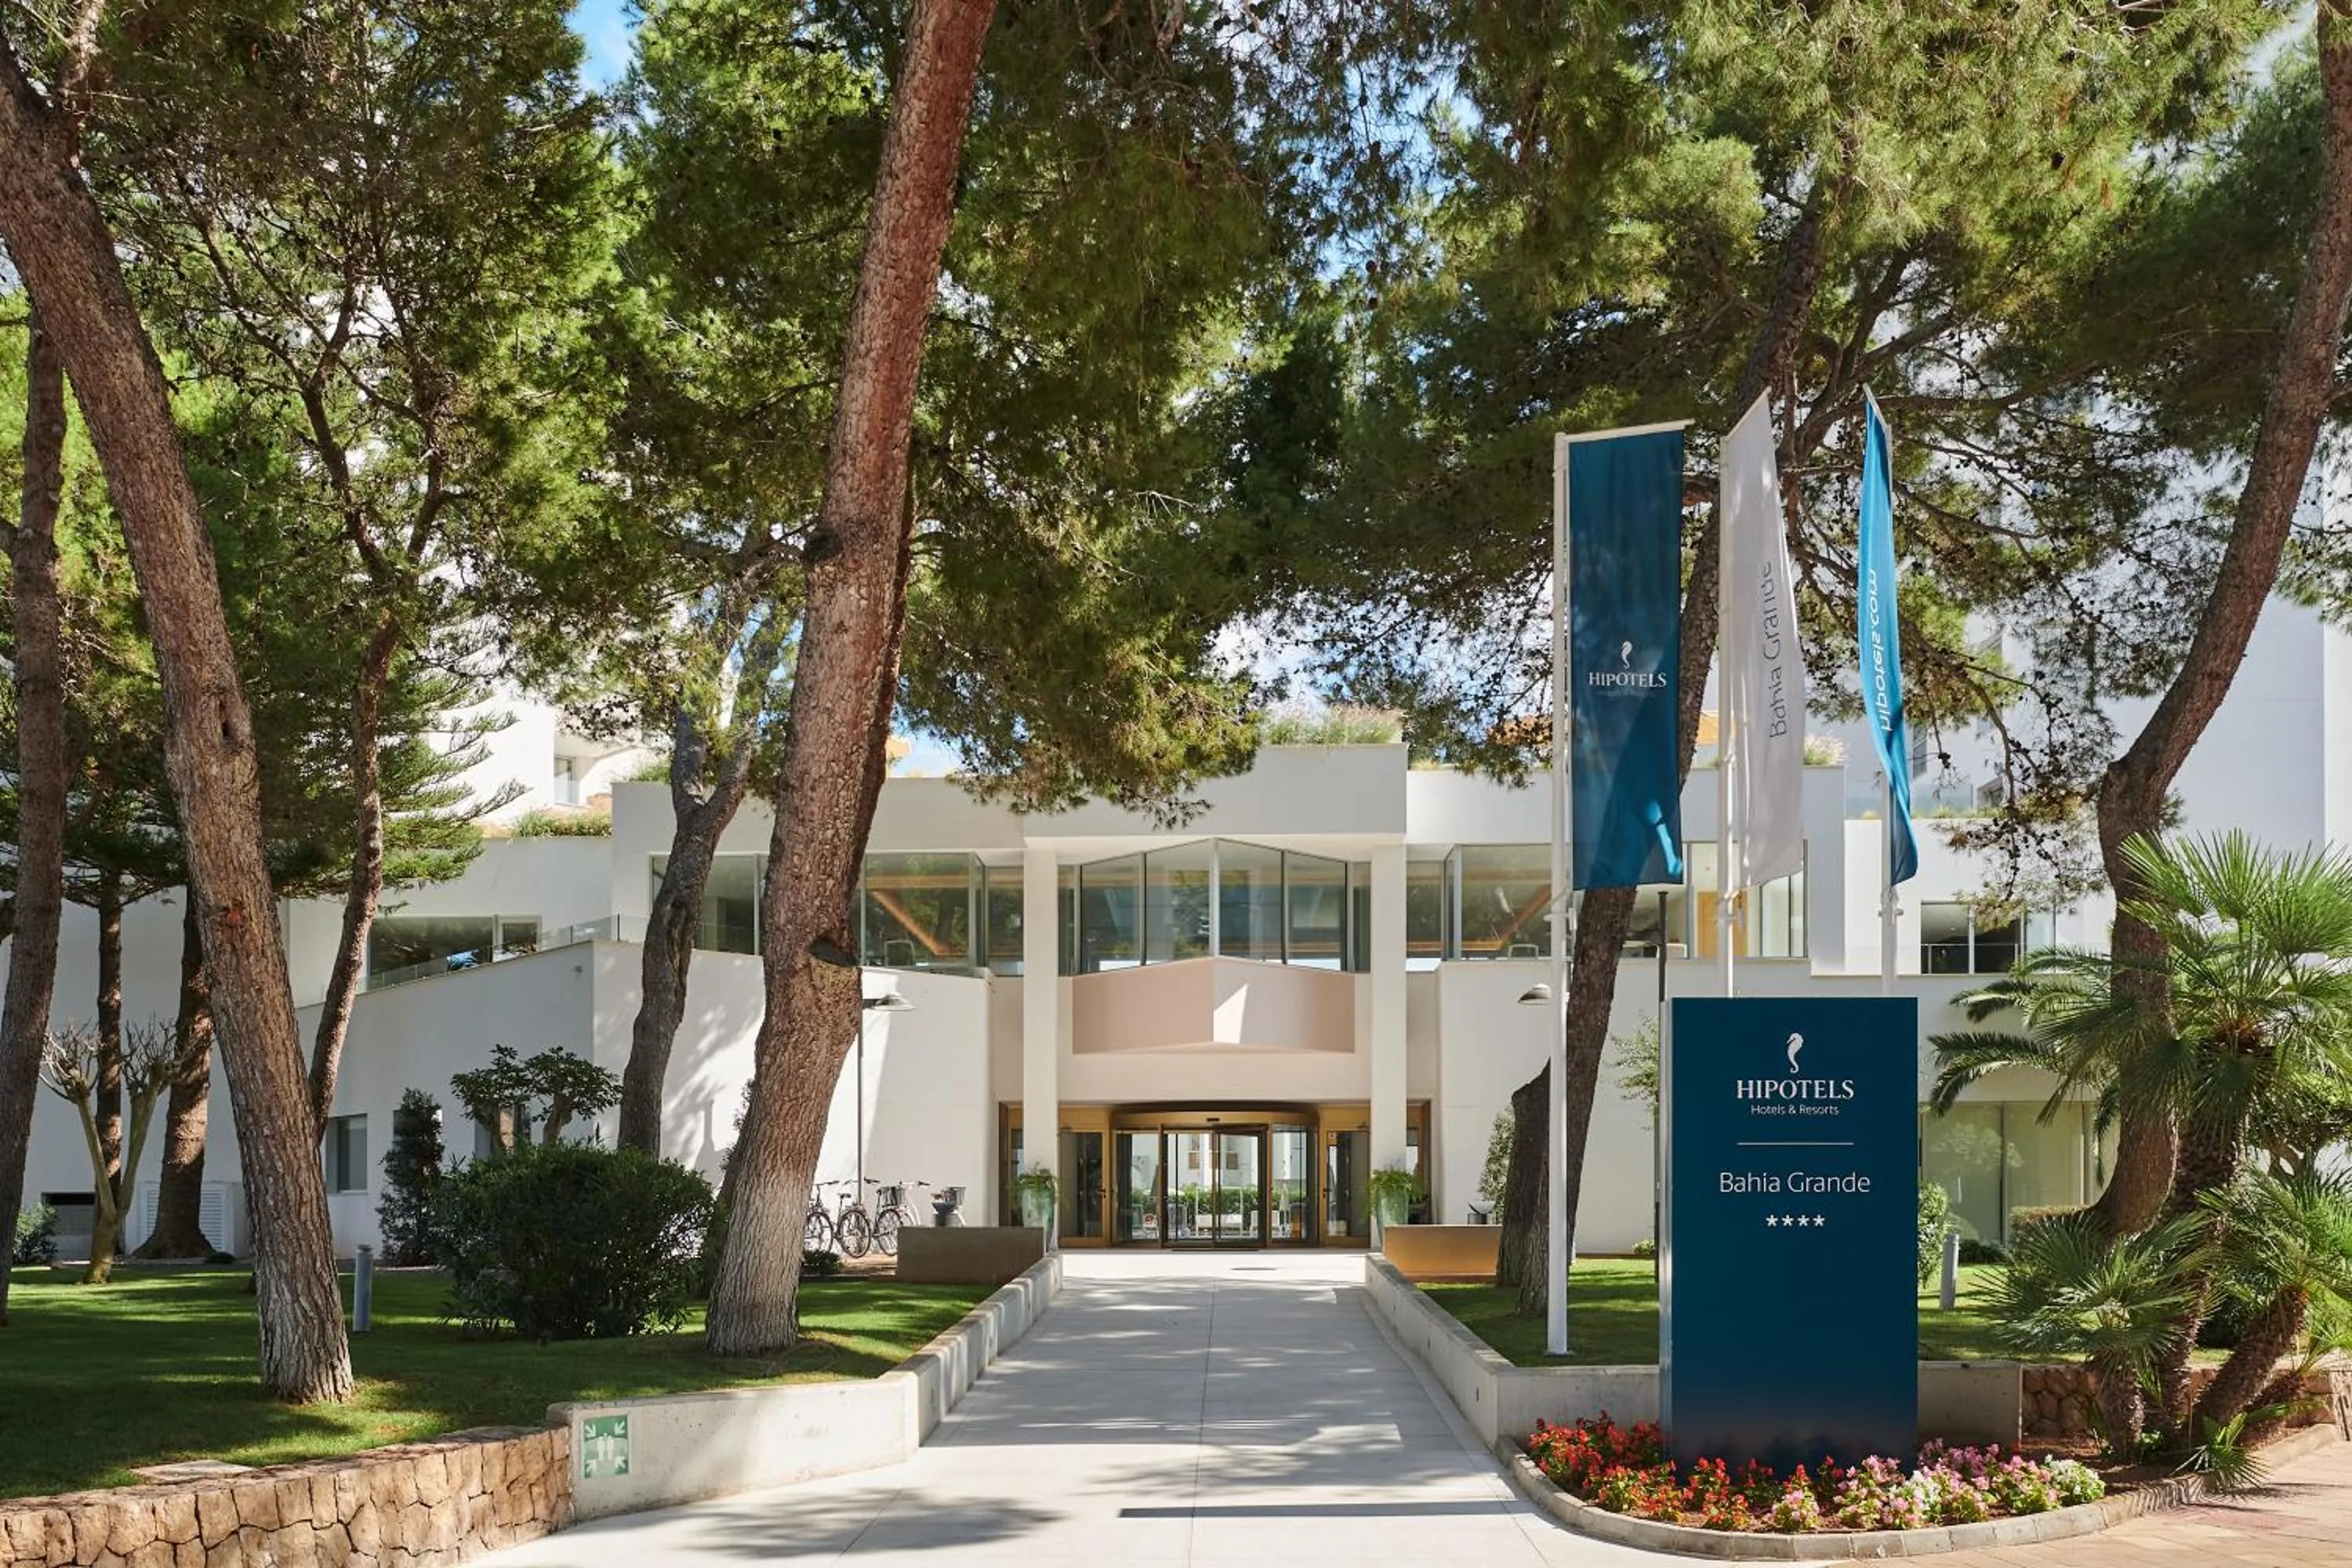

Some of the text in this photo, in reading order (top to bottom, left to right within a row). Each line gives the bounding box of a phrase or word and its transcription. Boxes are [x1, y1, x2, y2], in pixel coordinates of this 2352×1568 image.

[1588, 671, 1668, 688] HIPOTELS
[1736, 1079, 1855, 1100] HIPOTELS
[1750, 1104, 1840, 1116] Hotels & Resorts
[1787, 1171, 1871, 1192] Grande
